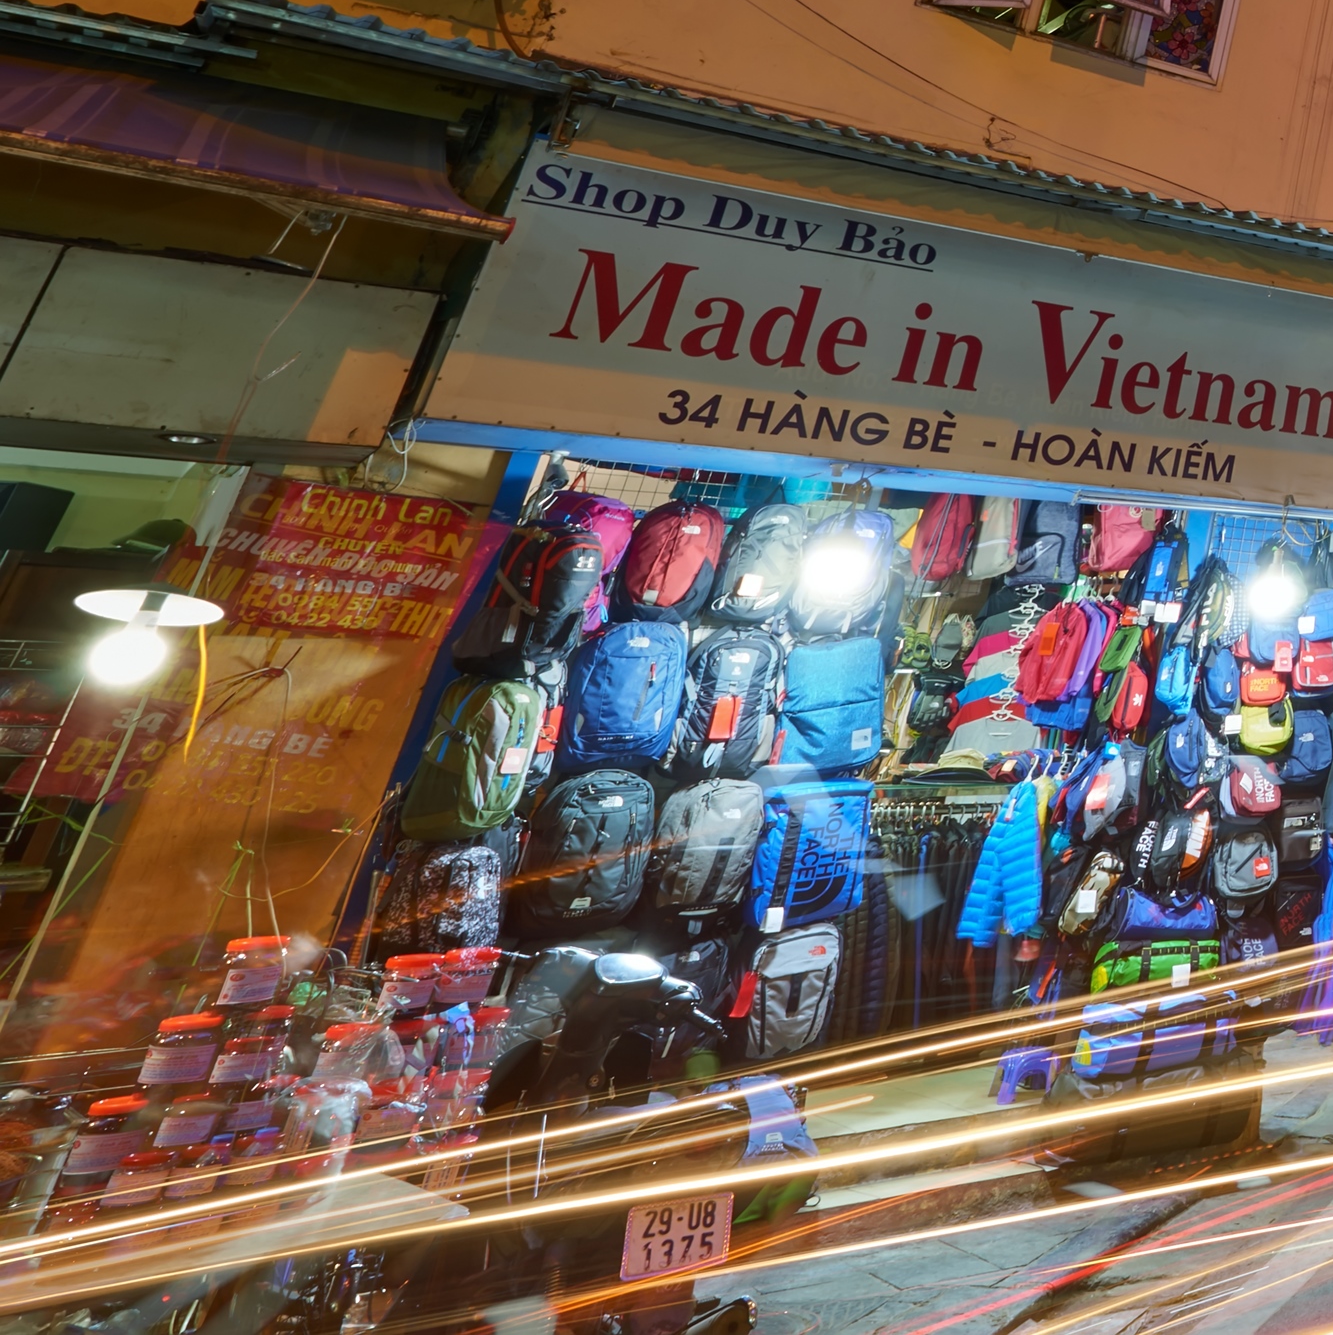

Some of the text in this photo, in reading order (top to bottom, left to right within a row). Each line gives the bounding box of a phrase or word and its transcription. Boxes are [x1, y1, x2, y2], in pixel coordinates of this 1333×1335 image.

[526, 163, 938, 268] Shop Duy Bảo
[548, 248, 869, 377] Made
[890, 302, 984, 392] in
[658, 389, 723, 430] 34
[736, 389, 891, 447] HÀNG
[902, 409, 957, 454] BÈ
[1010, 427, 1138, 473] HOÀN
[1147, 438, 1237, 484] KIẾM
[797, 826, 825, 880] FACE
[816, 801, 845, 878] NORTH
[833, 831, 855, 876] THE
[642, 1199, 717, 1239] 29-U8
[642, 1231, 715, 1271] 1375
